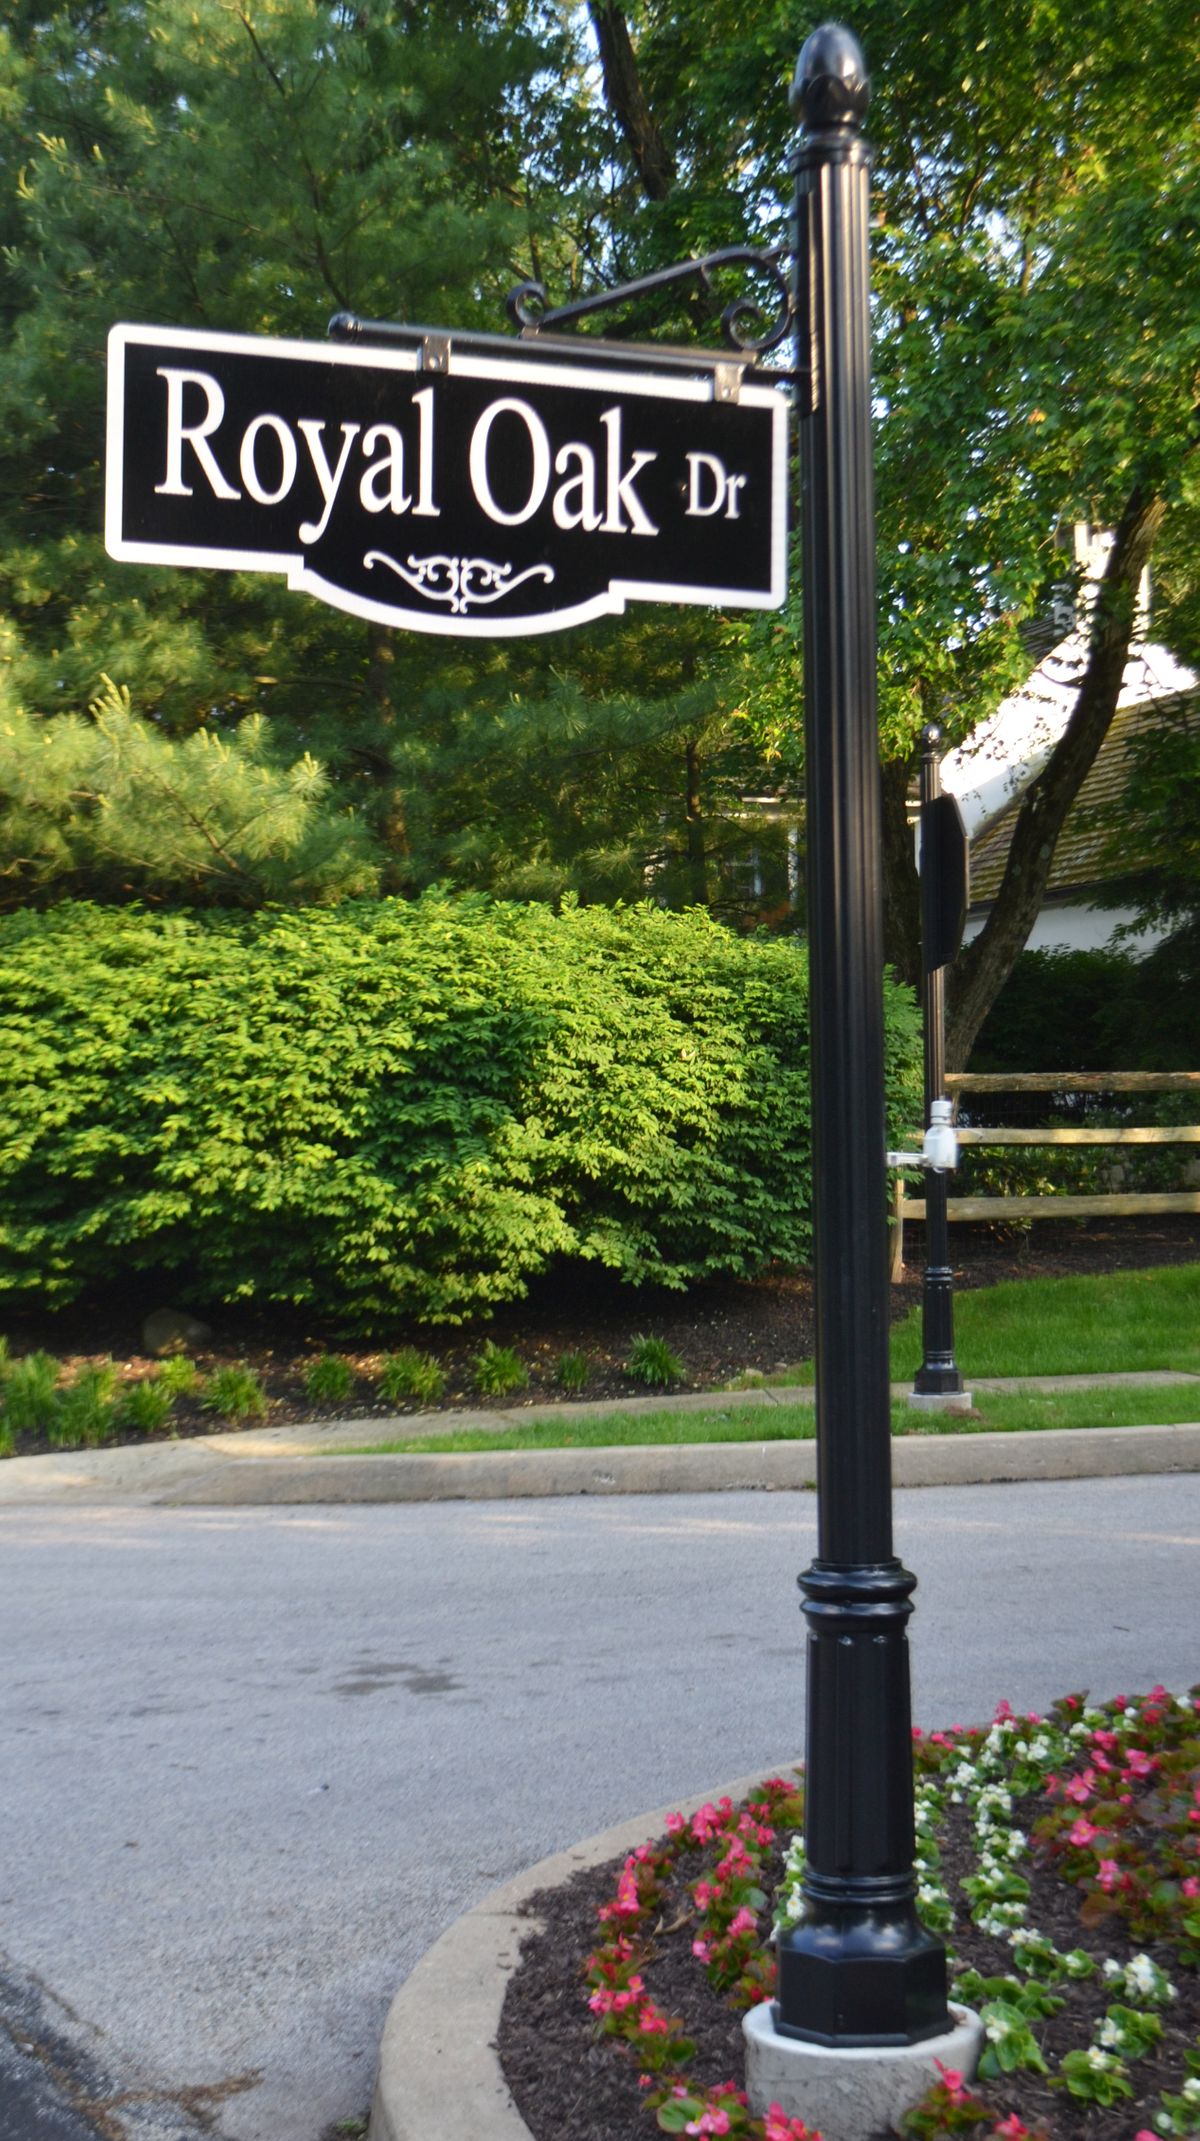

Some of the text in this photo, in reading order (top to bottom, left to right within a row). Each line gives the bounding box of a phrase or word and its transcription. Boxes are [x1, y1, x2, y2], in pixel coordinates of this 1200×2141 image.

[154, 367, 747, 545] Royal Oak Dr
